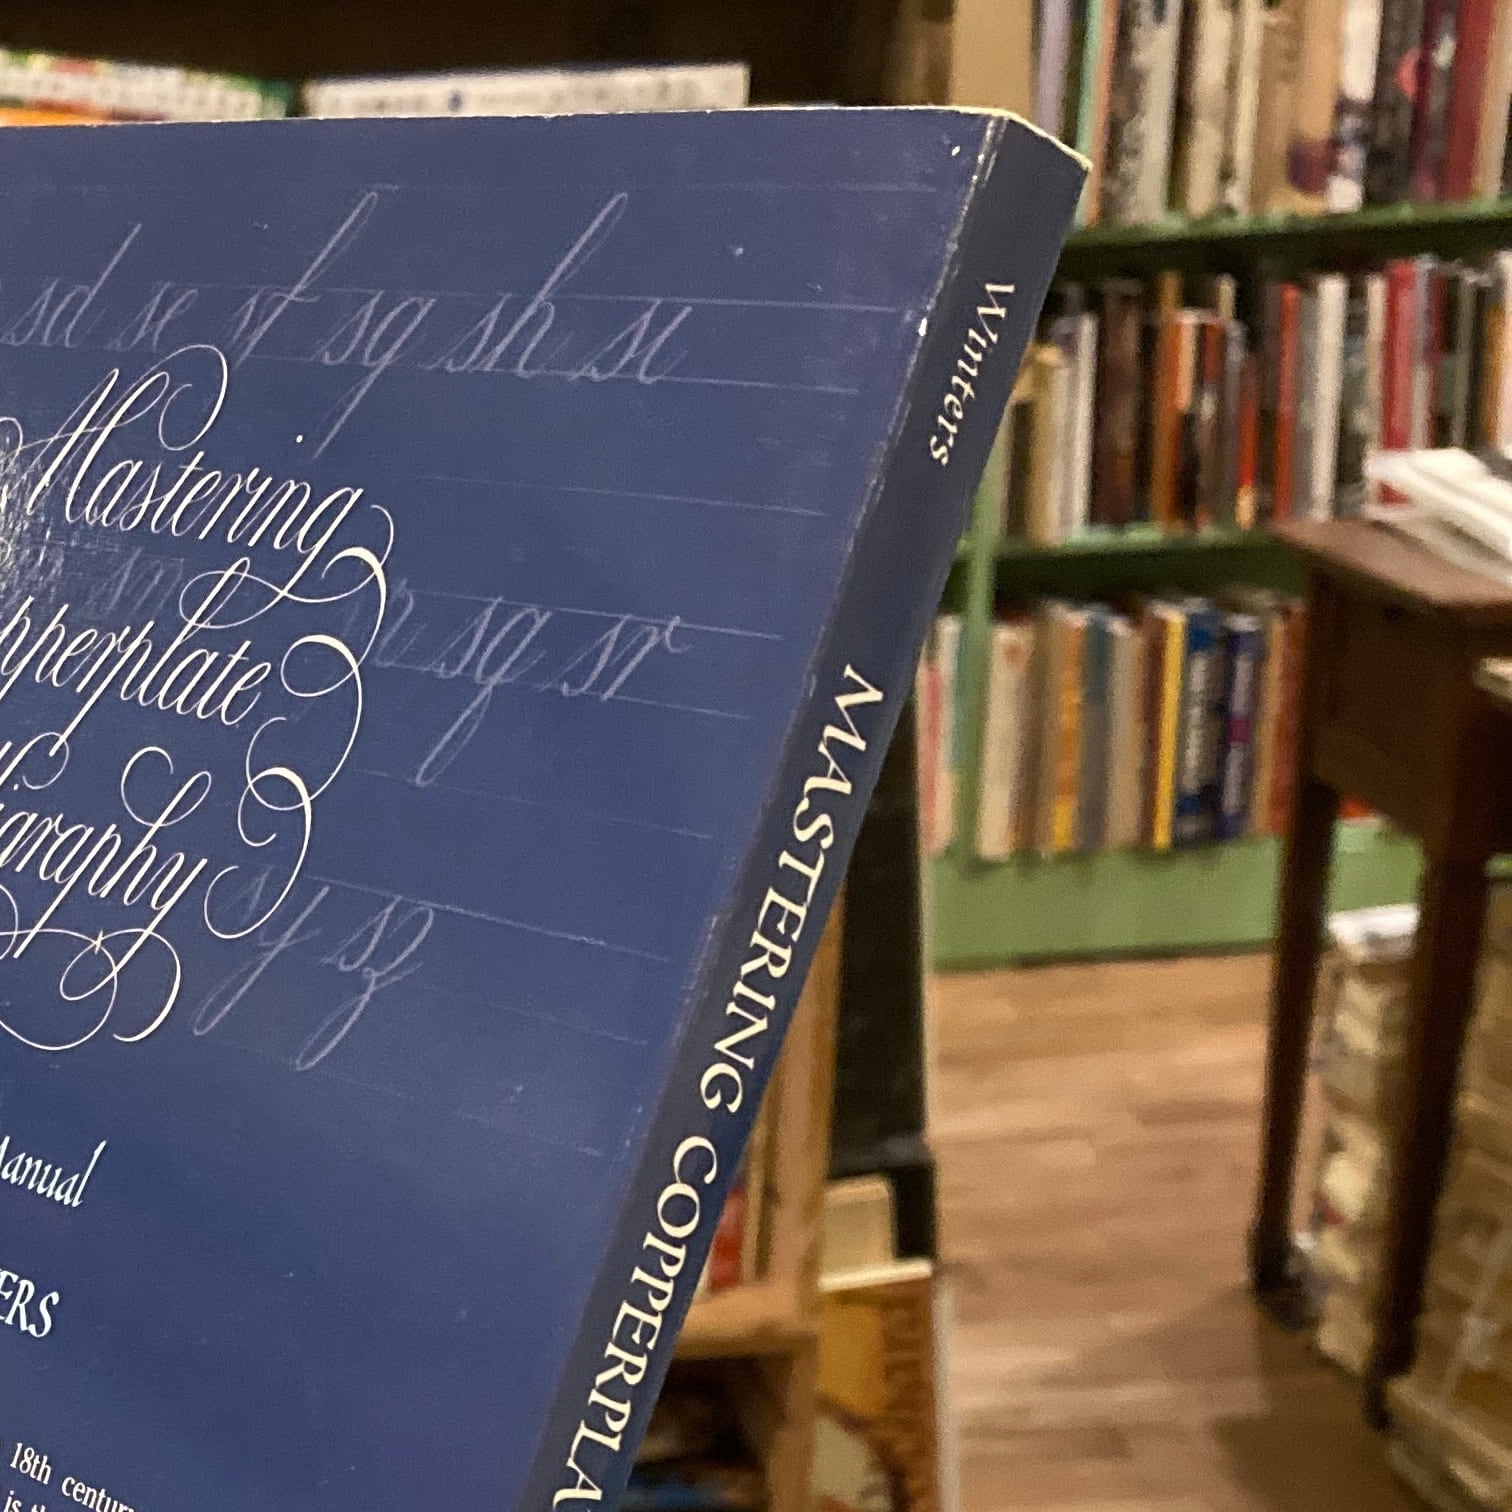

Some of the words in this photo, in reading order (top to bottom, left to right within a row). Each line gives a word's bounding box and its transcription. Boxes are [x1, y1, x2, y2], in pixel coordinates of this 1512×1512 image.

[929, 281, 1016, 467] Winters
[700, 664, 884, 1114] MASTERING
[9, 1442, 53, 1487] 18th
